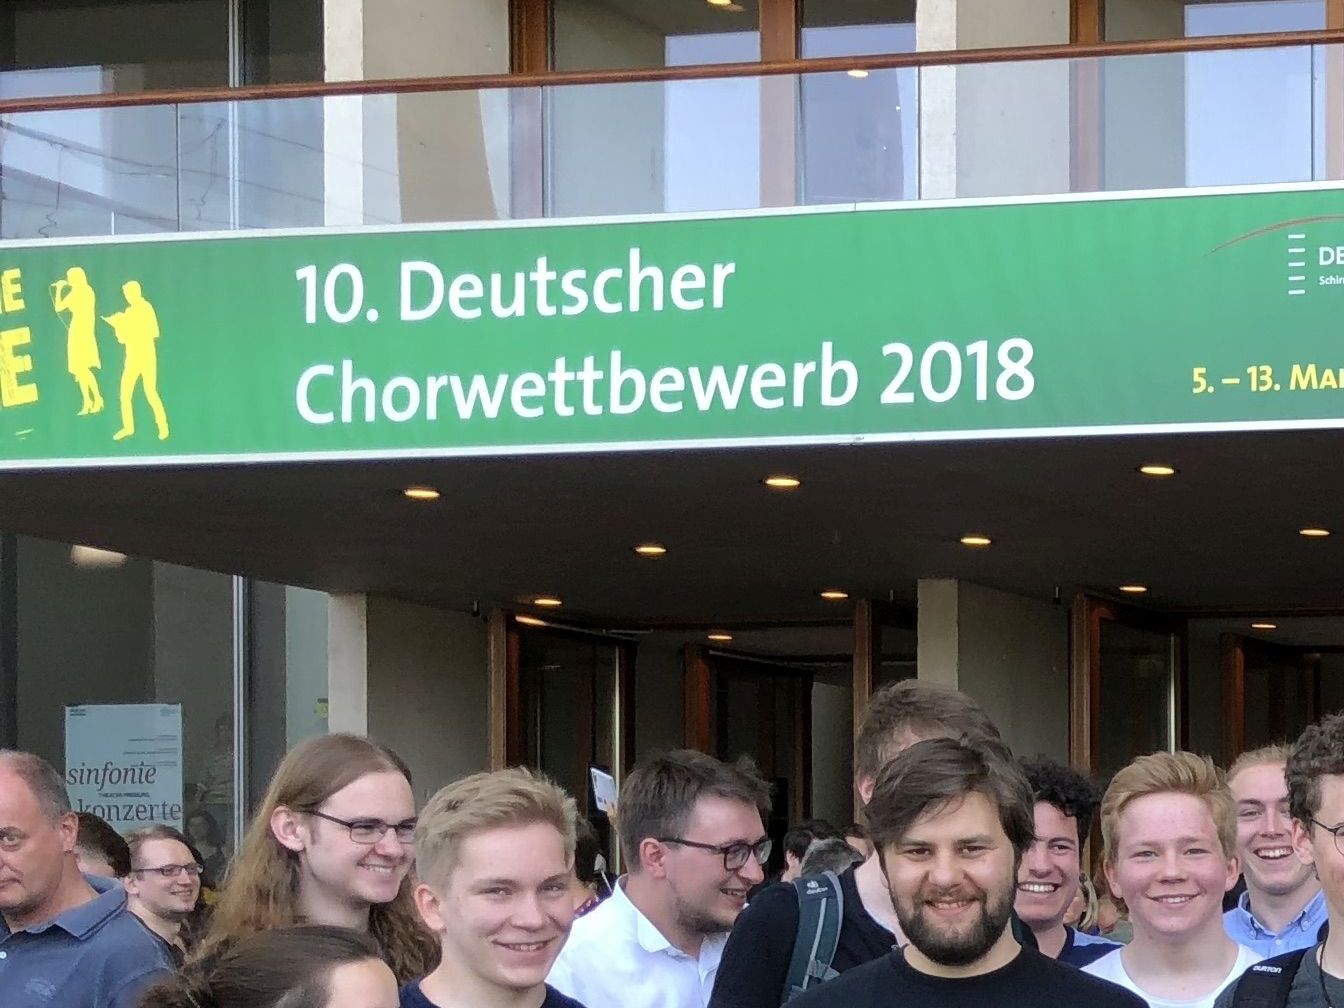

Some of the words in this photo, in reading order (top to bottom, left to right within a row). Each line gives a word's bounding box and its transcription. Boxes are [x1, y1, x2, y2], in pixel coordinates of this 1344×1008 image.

[295, 264, 380, 325] 10.
[401, 247, 737, 322] Deutscher
[296, 340, 859, 425] Chorwettbewerb
[879, 336, 1037, 406] 2018
[1191, 366, 1215, 394] 5.
[1246, 364, 1282, 393] 13.
[66, 761, 157, 792] sinfonie
